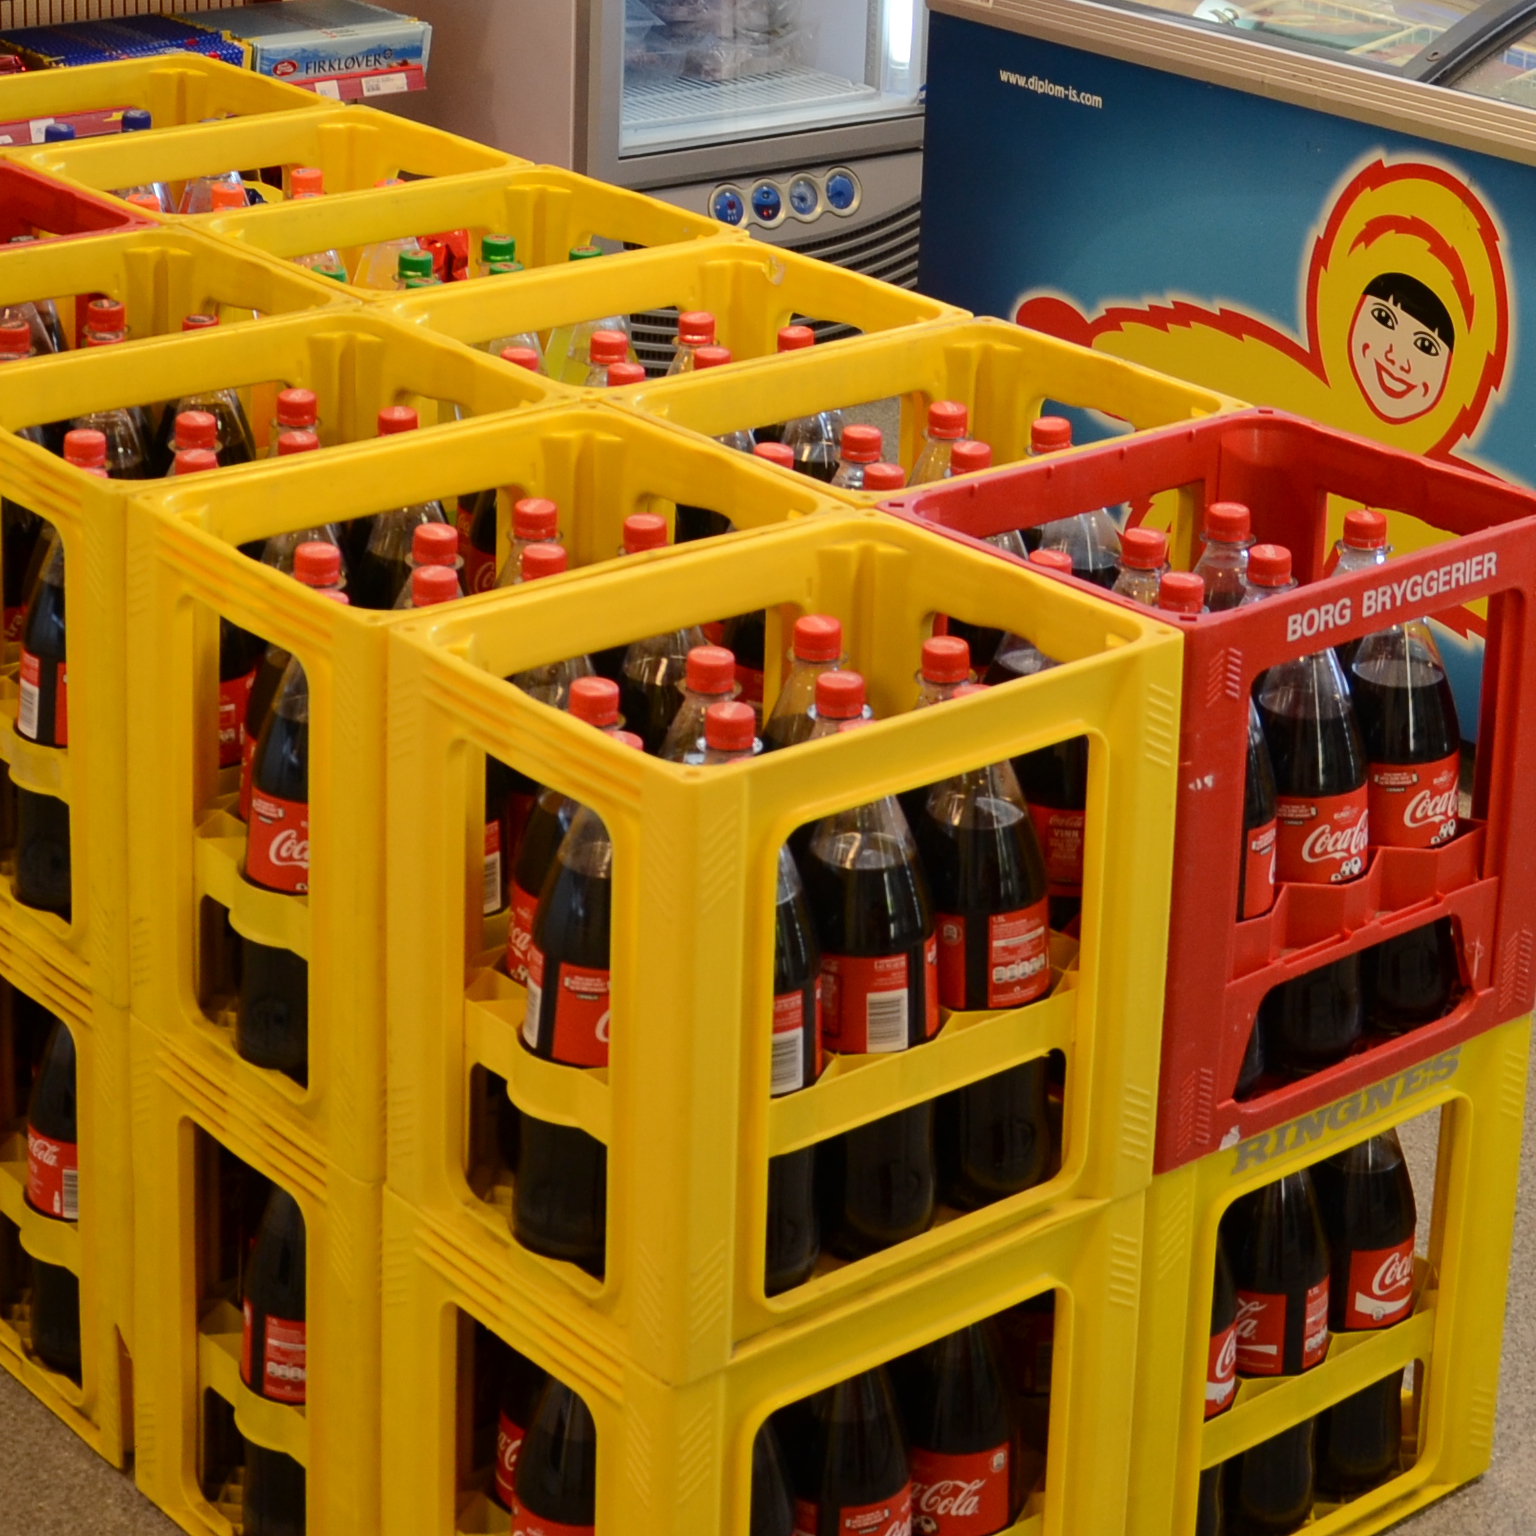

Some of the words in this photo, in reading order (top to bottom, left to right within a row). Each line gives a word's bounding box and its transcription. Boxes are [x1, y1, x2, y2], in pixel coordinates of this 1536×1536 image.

[305, 52, 382, 75] FIRKLØVER
[999, 68, 1103, 109] www.diplom-is.com
[1287, 598, 1352, 643] BORG
[1362, 551, 1498, 619] BRYGGERIER
[1232, 1046, 1462, 1176] RINGNES
